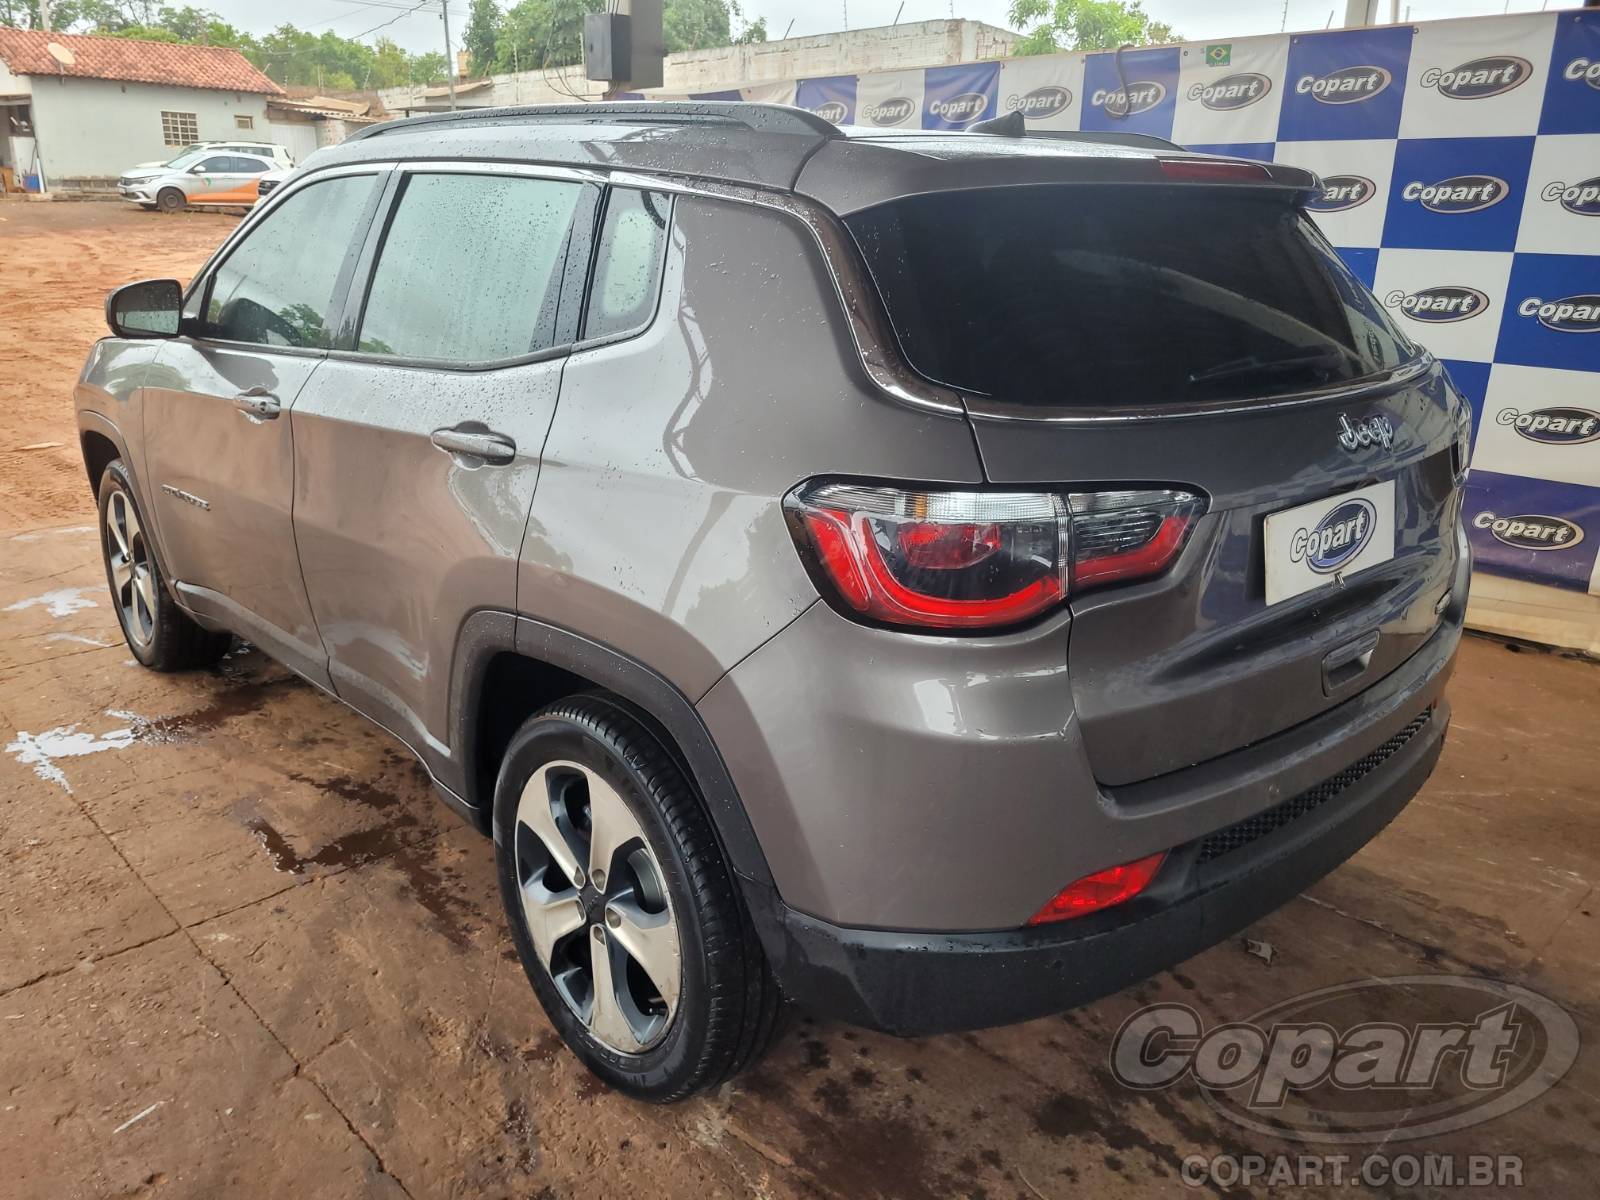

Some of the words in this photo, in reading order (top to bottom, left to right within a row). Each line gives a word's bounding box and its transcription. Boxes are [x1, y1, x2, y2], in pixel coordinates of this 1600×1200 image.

[1296, 73, 1378, 96] Copart
[1420, 63, 1517, 90] Copart
[1006, 93, 1062, 111] Copart
[1092, 87, 1158, 105] Copart
[1187, 80, 1258, 101] Copart
[806, 107, 841, 120] part
[862, 104, 908, 120] Copart
[930, 97, 981, 117] Copart
[1402, 181, 1494, 206] Copart
[1385, 290, 1474, 313] Copart
[1519, 298, 1600, 322] Copar
[1338, 413, 1393, 450] Jeep
[1496, 408, 1594, 435] Copart
[1290, 506, 1366, 563] Copart
[1473, 510, 1569, 543] Copart
